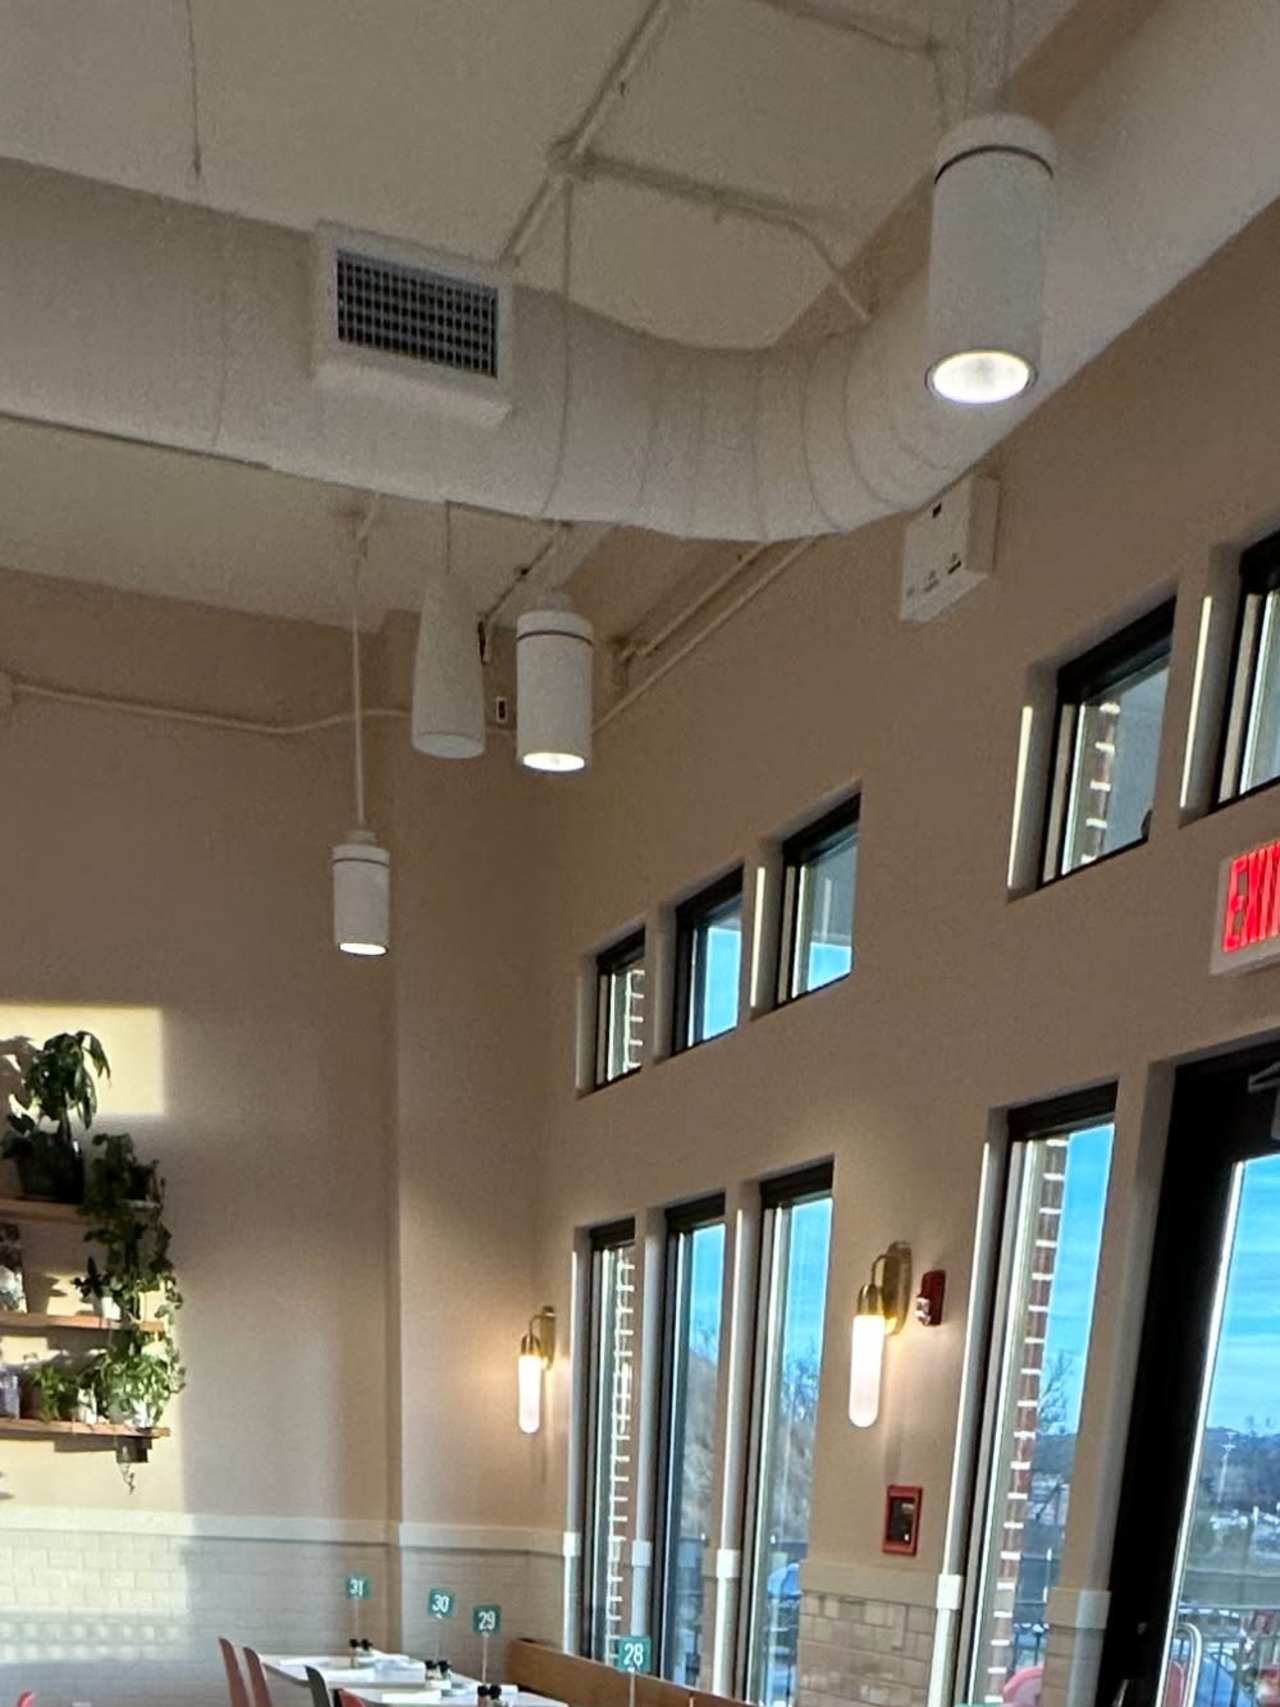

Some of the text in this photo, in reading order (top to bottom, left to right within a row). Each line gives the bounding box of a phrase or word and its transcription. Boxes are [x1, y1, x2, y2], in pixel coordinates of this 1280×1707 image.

[349, 1578, 364, 1597] 31
[431, 1594, 450, 1613] 30
[478, 1611, 496, 1631] 29
[623, 1643, 644, 1667] 28
